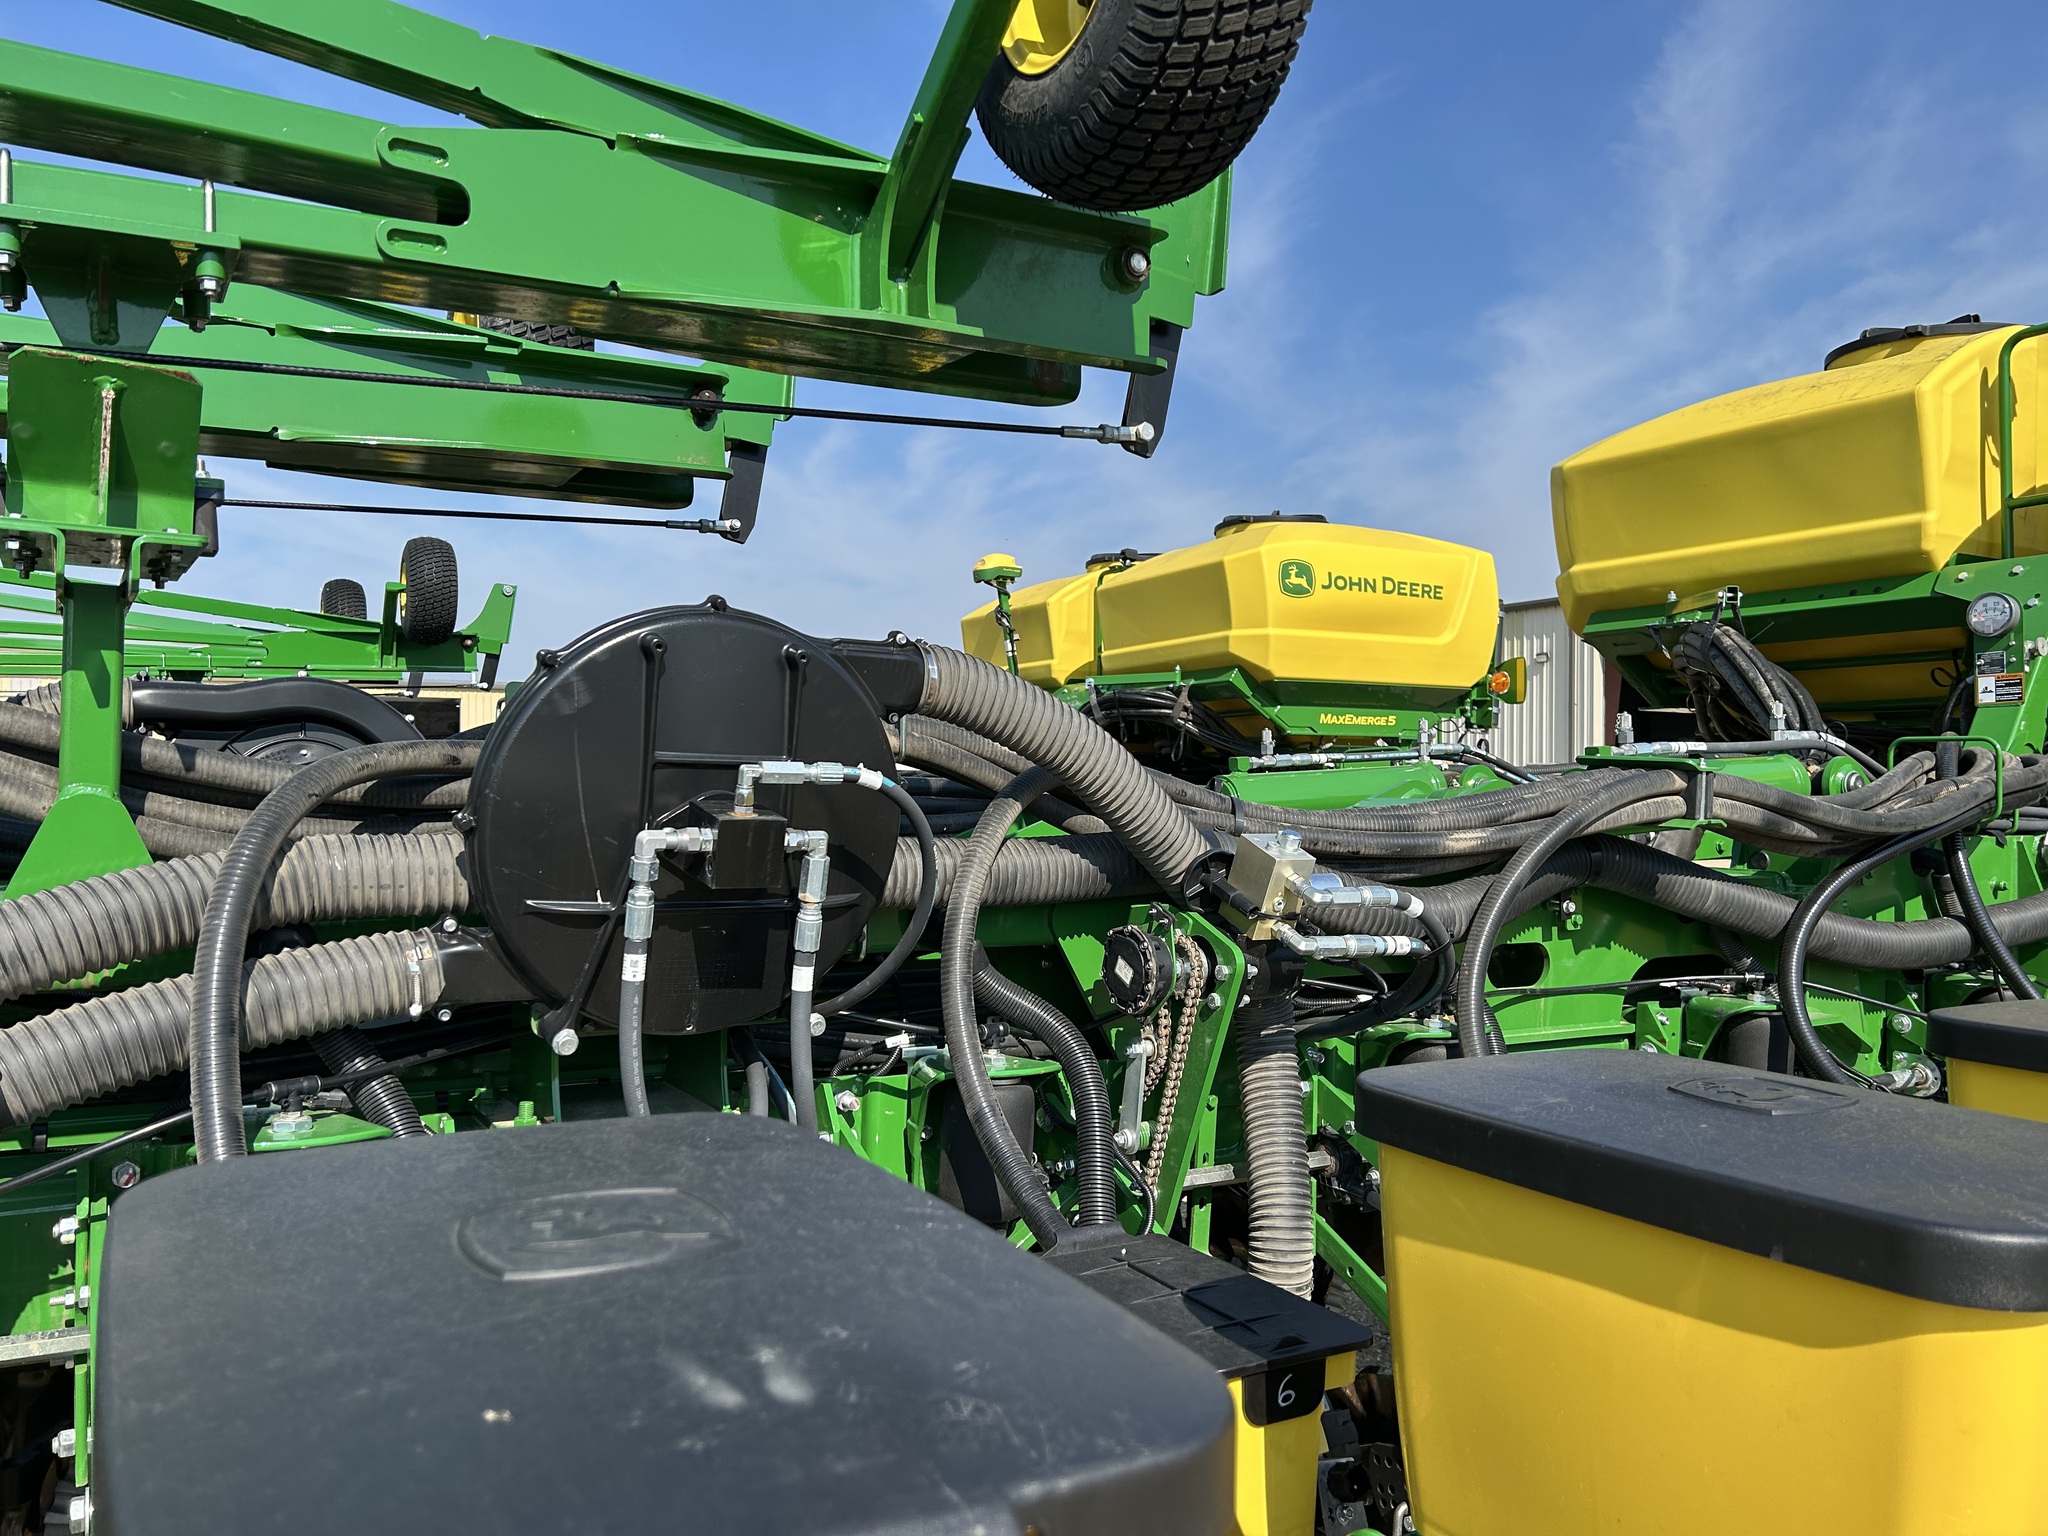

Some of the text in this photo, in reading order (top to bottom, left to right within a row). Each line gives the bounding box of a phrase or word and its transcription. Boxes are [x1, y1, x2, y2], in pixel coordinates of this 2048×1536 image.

[1321, 571, 1444, 600] JOHN DEERE
[1278, 1373, 1296, 1407] 6
